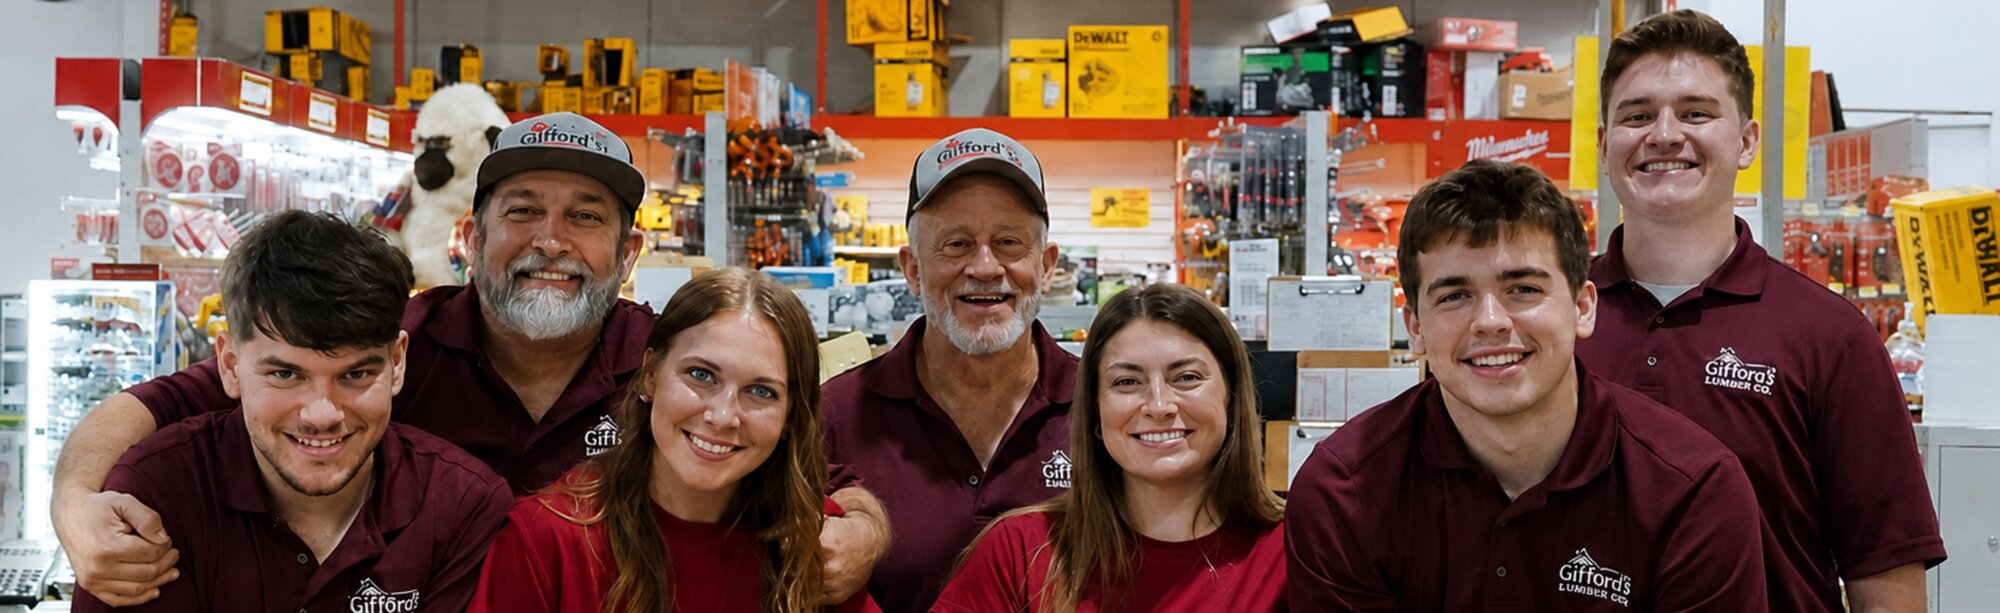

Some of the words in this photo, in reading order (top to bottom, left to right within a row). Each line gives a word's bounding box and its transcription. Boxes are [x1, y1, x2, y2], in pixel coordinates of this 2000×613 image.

[1704, 376, 1751, 391] LUMBER
[1753, 384, 1772, 396] CO.
[1559, 563, 1631, 596] Gifford's
[1558, 583, 1608, 600] LUMBER
